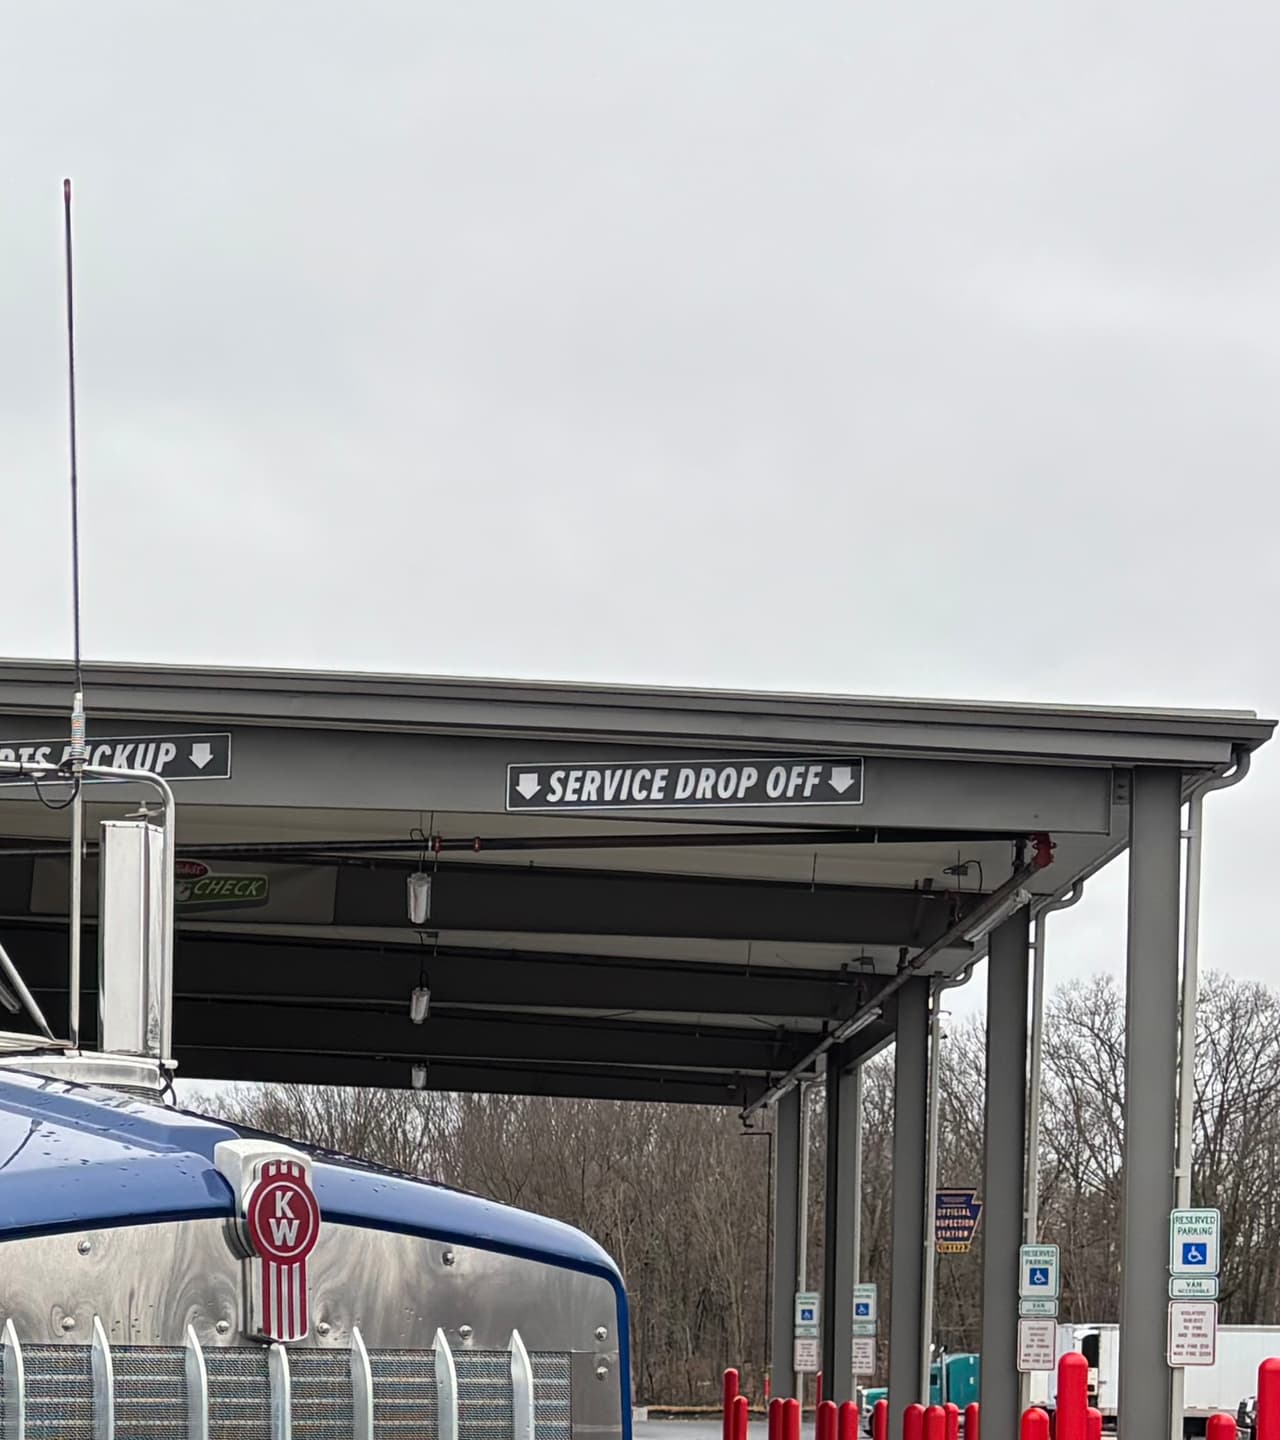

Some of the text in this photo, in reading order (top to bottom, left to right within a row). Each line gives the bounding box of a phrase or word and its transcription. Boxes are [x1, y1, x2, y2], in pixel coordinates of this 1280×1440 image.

[546, 765, 823, 802] SERVICE DROP OFF
[194, 879, 263, 896] CHECK
[1175, 1215, 1215, 1225] RESERVED
[1177, 1227, 1213, 1236] PARKING
